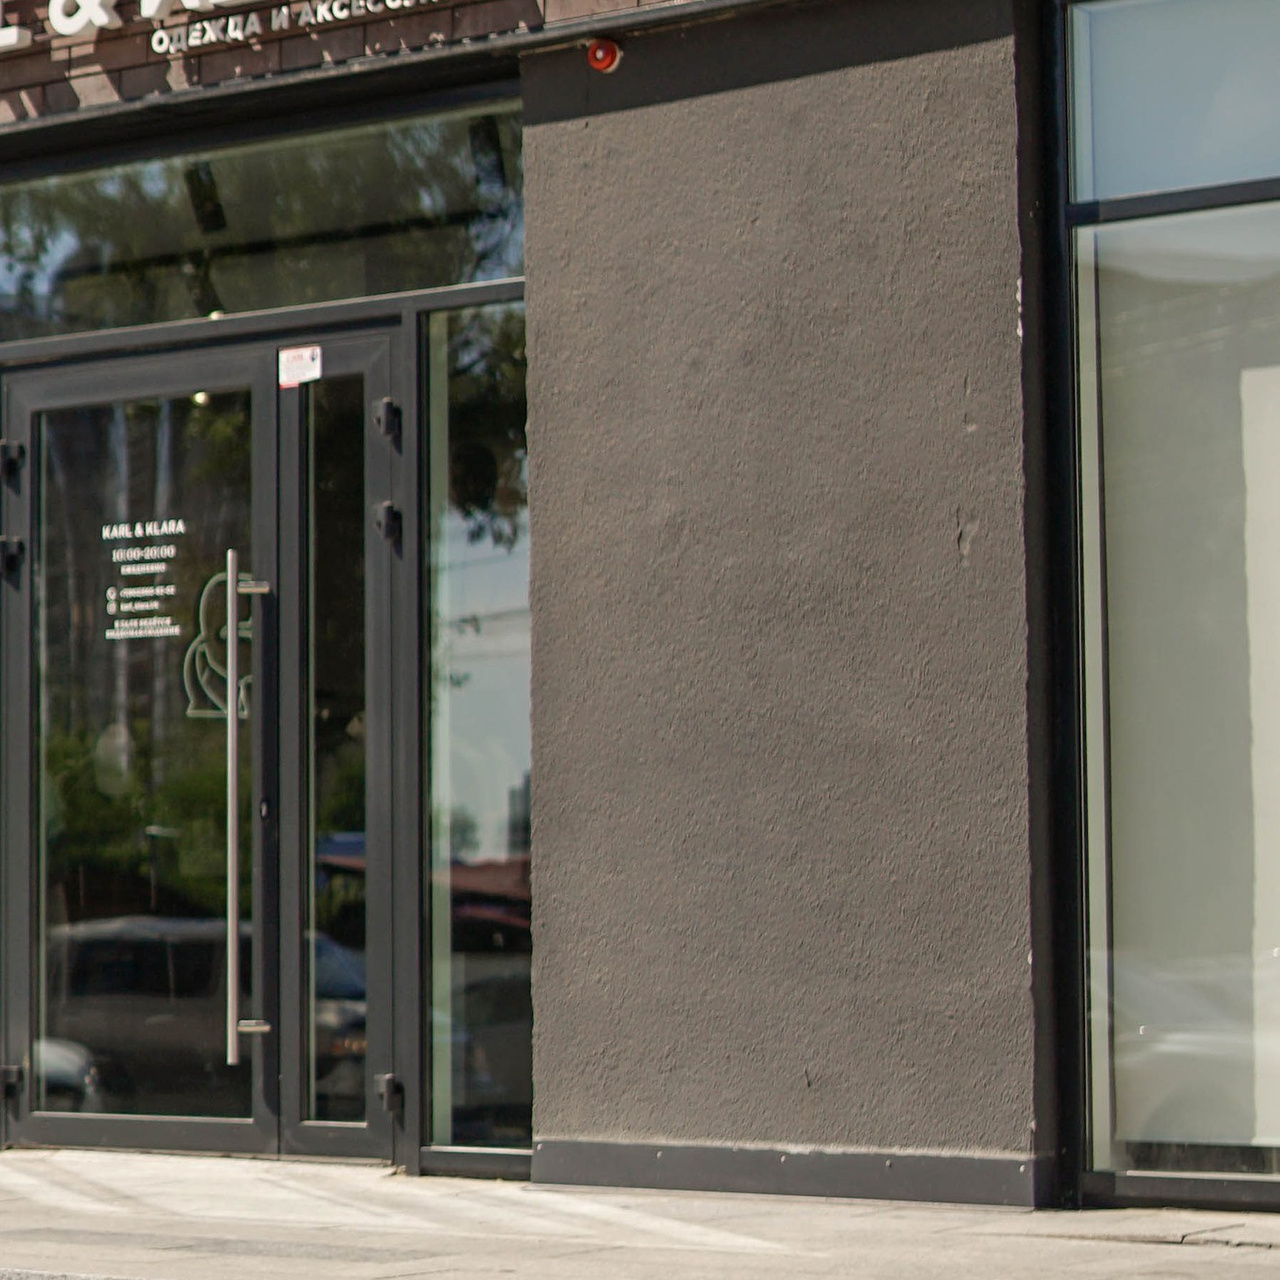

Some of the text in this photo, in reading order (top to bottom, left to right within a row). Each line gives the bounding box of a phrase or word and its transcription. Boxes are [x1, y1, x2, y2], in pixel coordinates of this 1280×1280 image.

[150, 11, 262, 55] ОДЕЖДА
[270, 5, 290, 32] И
[102, 523, 133, 540] KARL
[145, 519, 186, 537] KLARA
